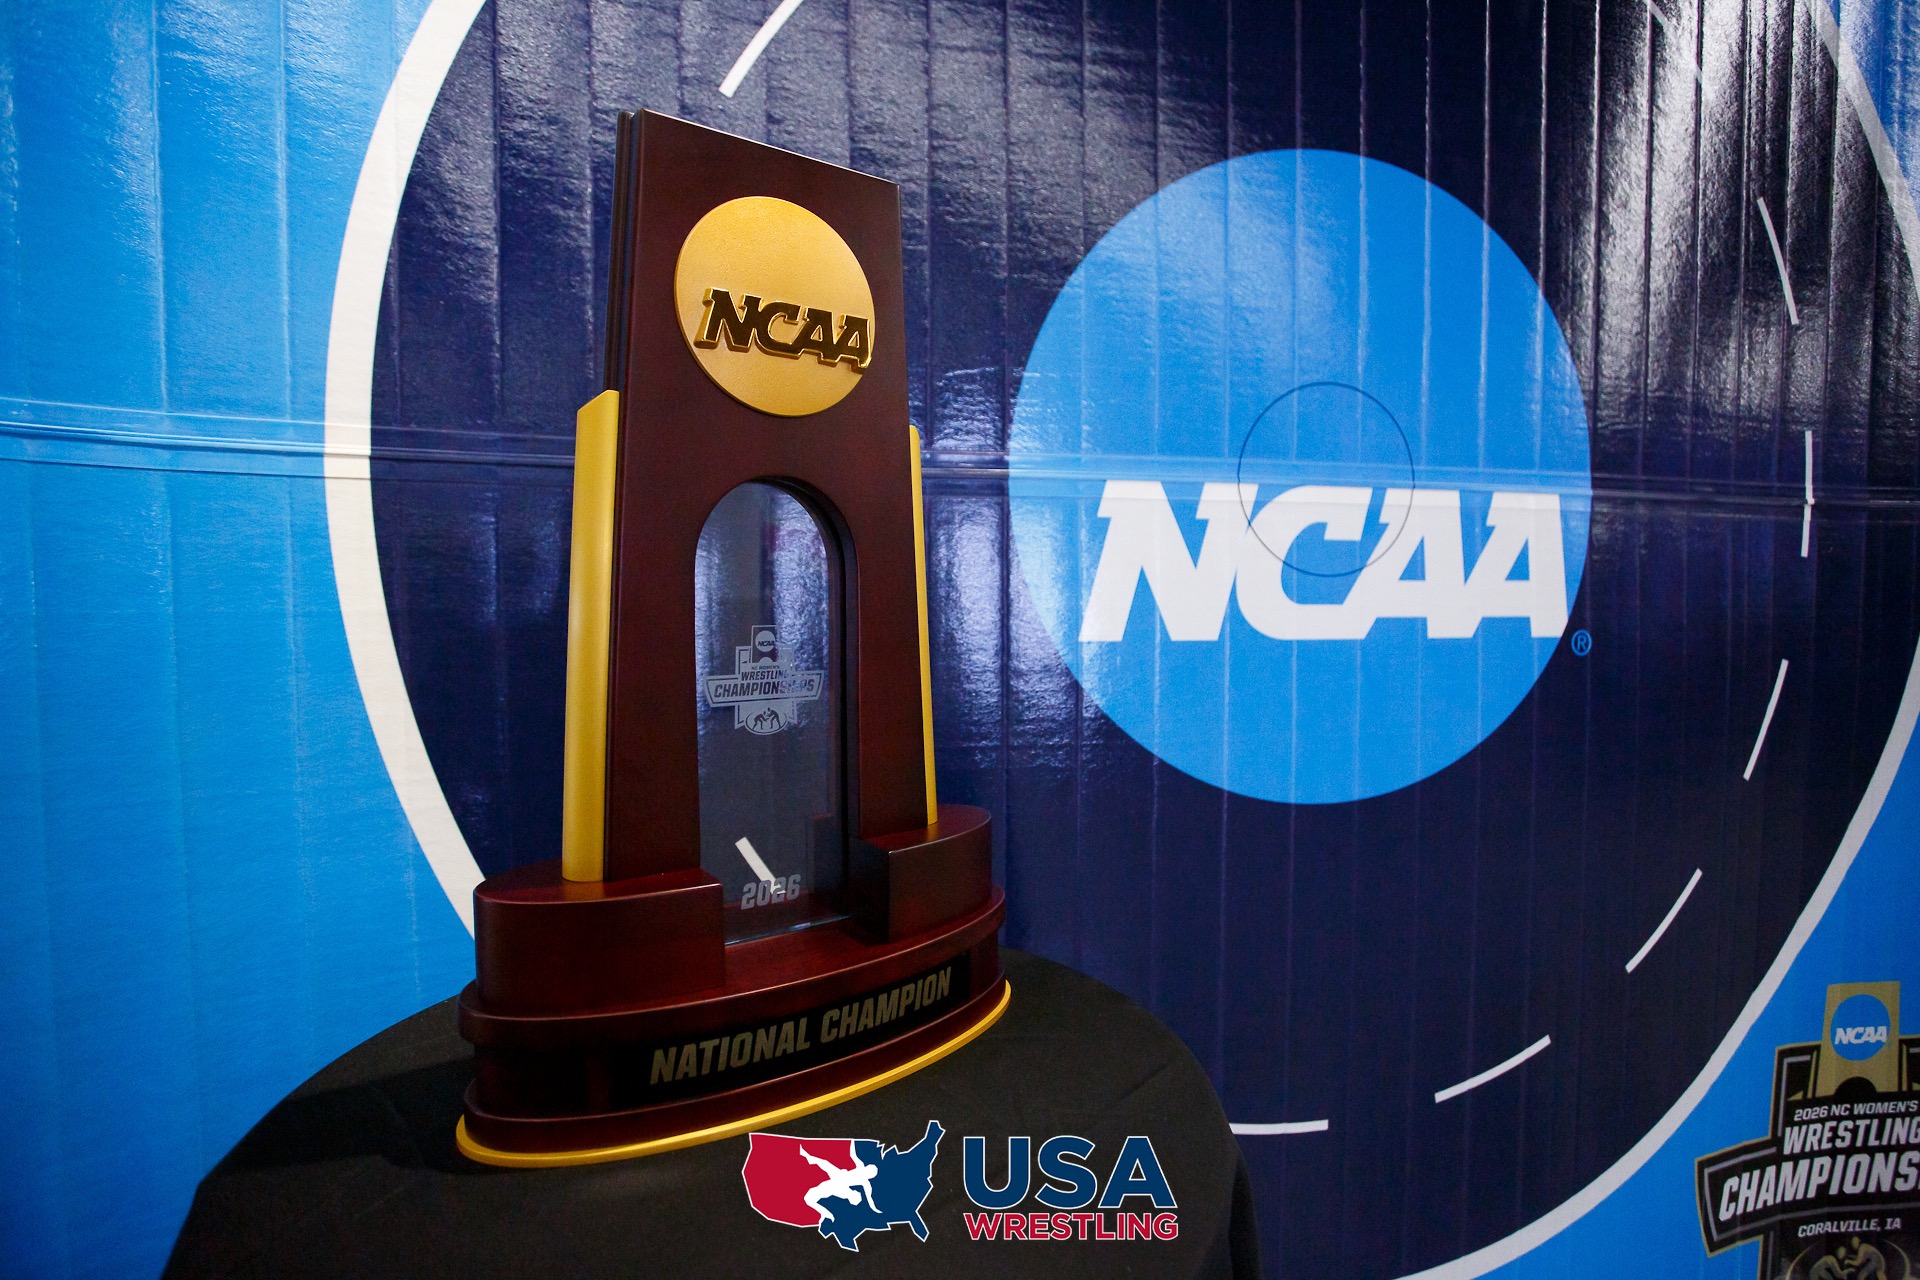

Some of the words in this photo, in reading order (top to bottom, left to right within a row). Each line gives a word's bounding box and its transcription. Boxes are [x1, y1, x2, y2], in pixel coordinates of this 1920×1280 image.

[694, 287, 872, 373] NCAA
[1078, 479, 1568, 642] NCAA
[741, 874, 801, 910] 2026
[650, 1021, 810, 1085] NATIONAL
[820, 966, 951, 1044] CHAMPION
[1834, 1026, 1889, 1045] NCAA
[1794, 1105, 1828, 1121] 2026
[1831, 1104, 1851, 1117] NC
[1853, 1100, 1918, 1115] WOMEN'S
[1783, 1116, 1920, 1155] WRESTLING
[1719, 1150, 1920, 1222] CHAMPIONS
[1797, 1218, 1881, 1238] CORALVILLE,
[1884, 1217, 1902, 1230] IA
